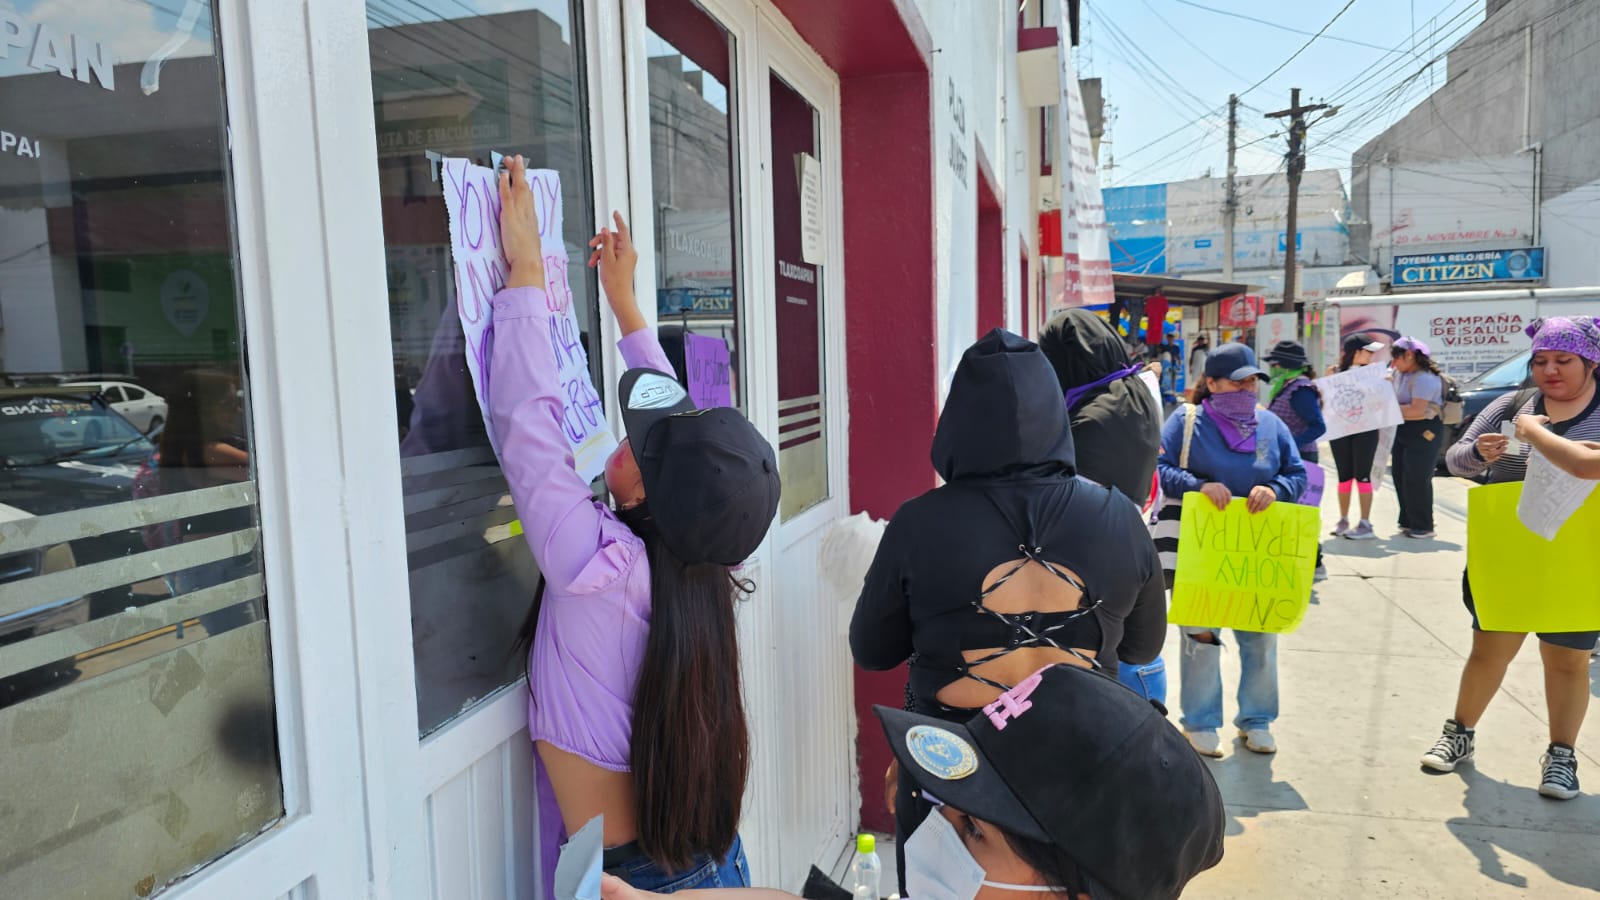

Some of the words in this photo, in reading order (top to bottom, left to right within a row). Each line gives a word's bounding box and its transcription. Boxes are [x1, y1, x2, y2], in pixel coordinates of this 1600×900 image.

[1426, 229, 1490, 242] NOVIEMBRE
[1397, 255, 1436, 265] JOYERÍA
[1448, 251, 1502, 262] RELOJERÍA
[1401, 263, 1496, 283] CITIZEN
[1433, 326, 1456, 336] DE
[1463, 325, 1522, 335] SALUD
[1442, 335, 1510, 346] VISUAL
